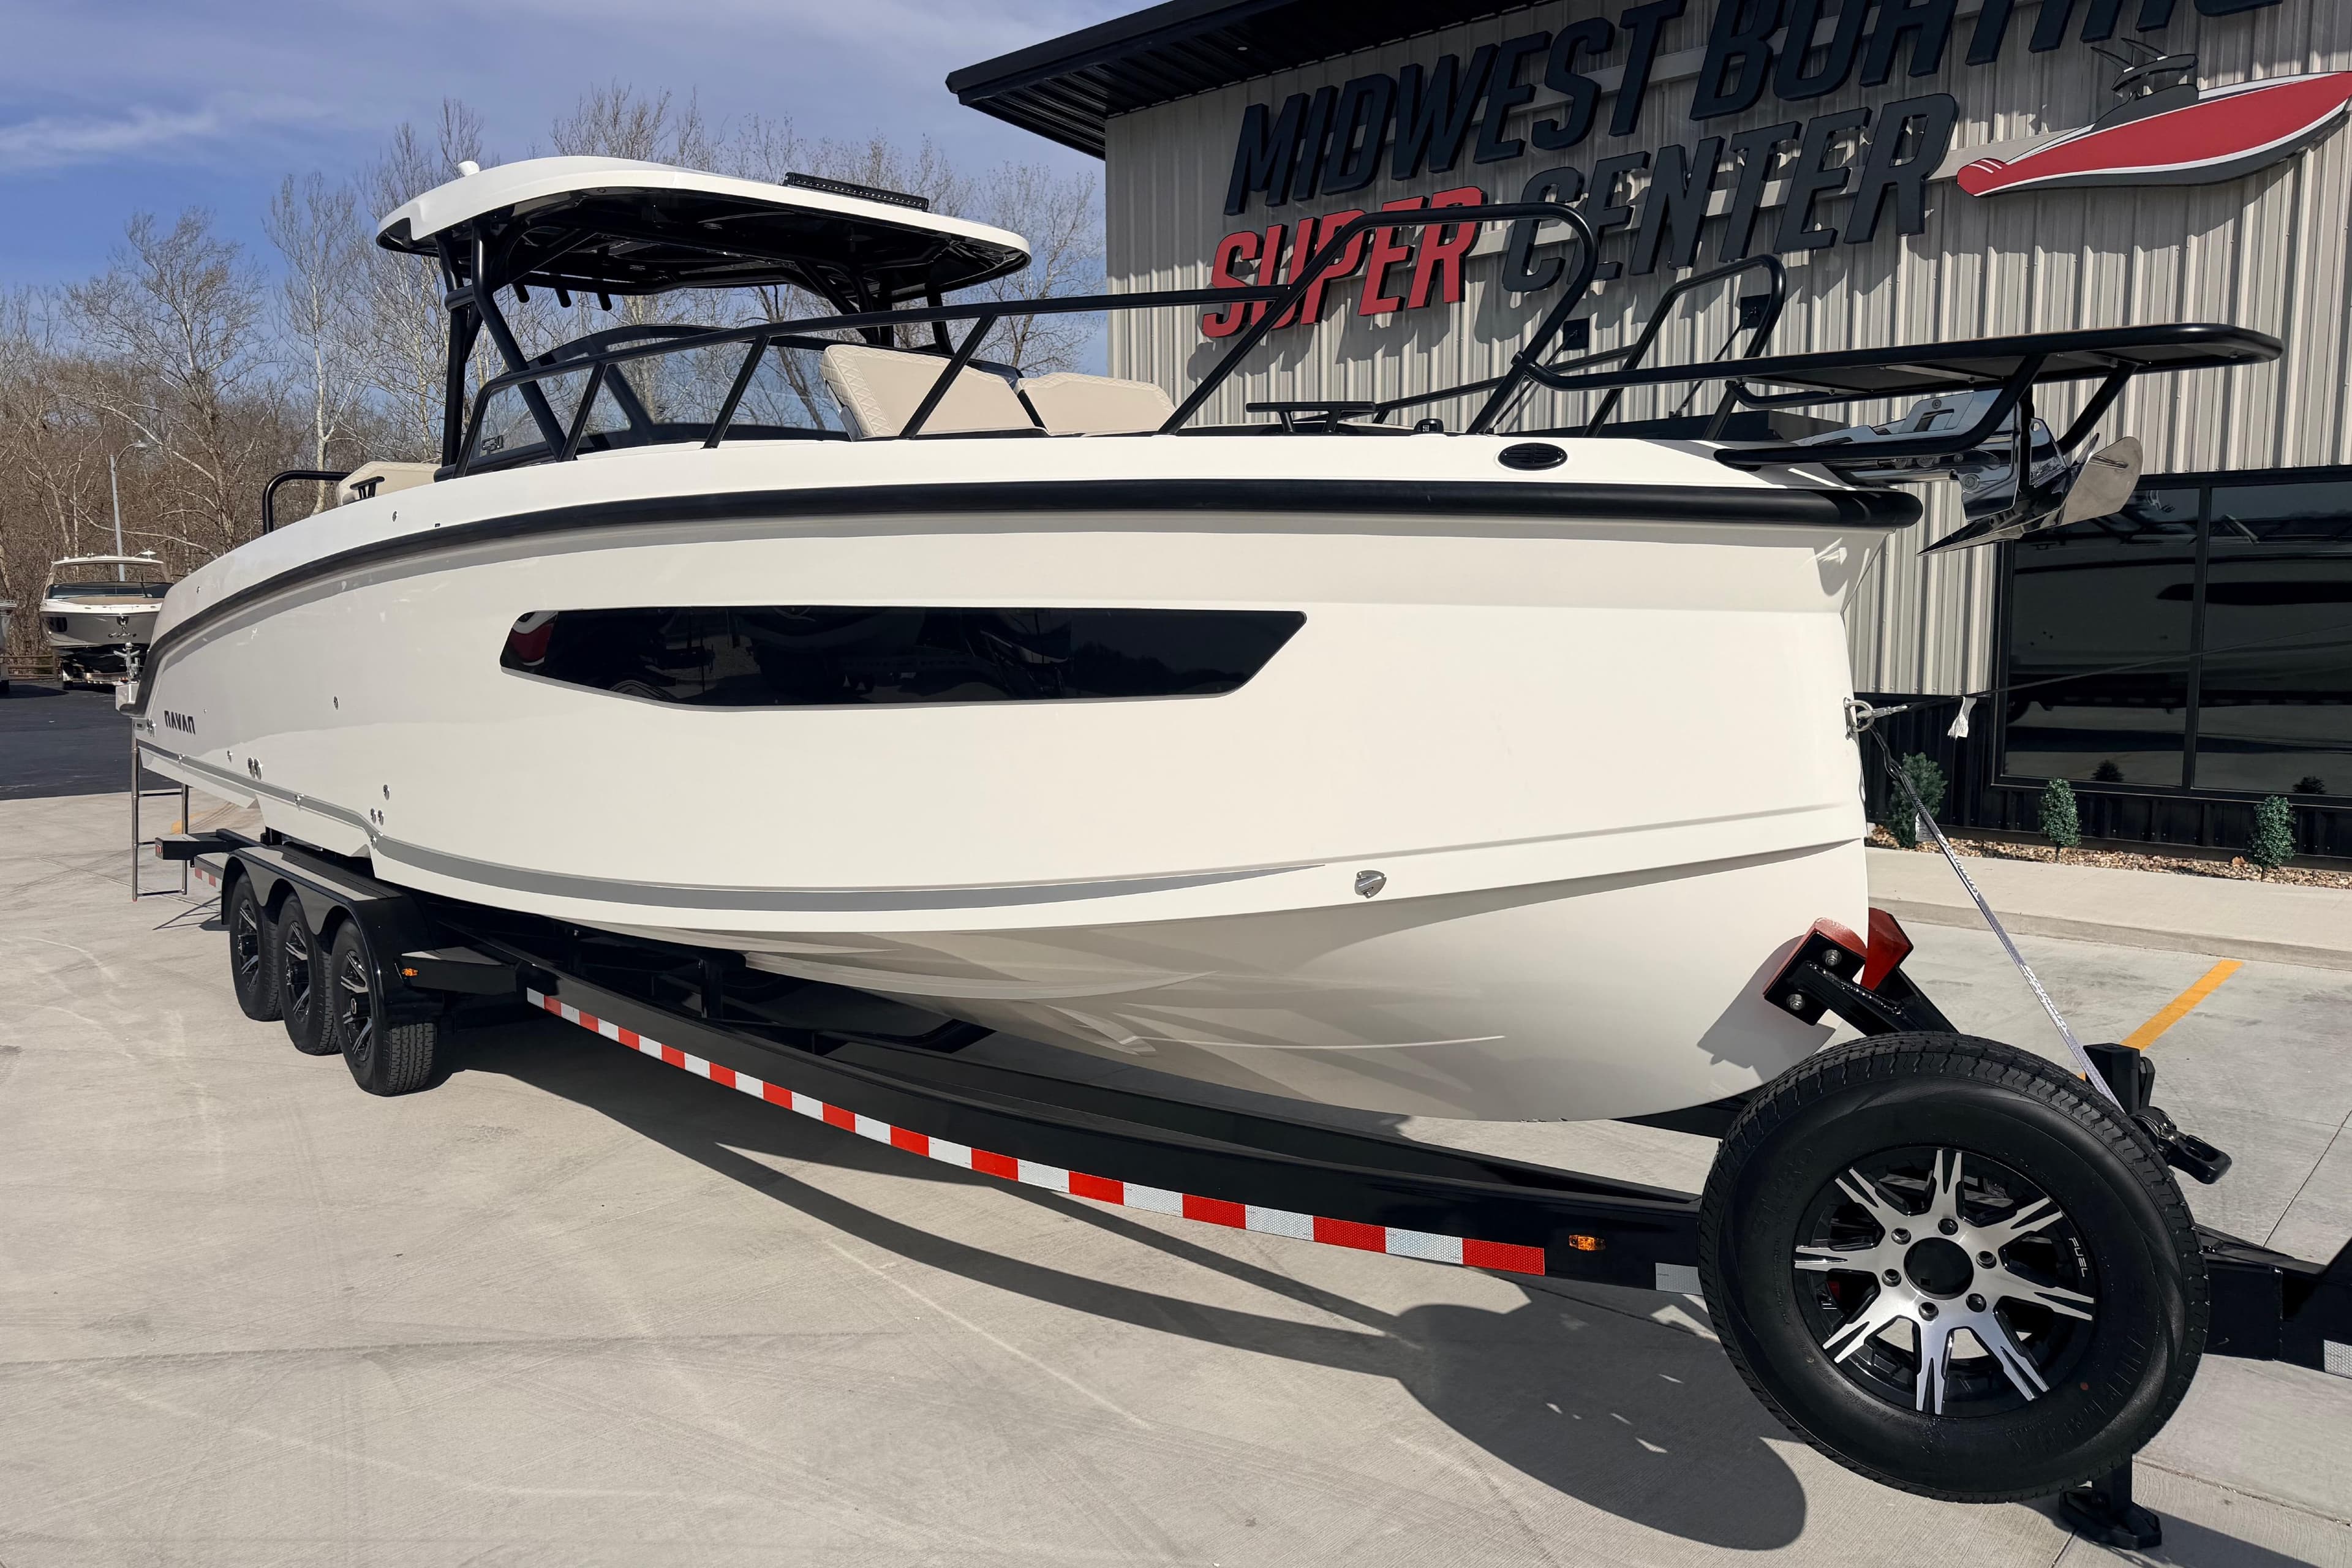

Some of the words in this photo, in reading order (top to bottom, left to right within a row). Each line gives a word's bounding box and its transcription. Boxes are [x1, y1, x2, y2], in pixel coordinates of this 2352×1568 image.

[1202, 186, 1488, 337] SUPER
[1502, 93, 1959, 292] CENTER
[1224, 0, 1687, 216] MIDWEST
[2068, 1237, 2087, 1277] FUEL
